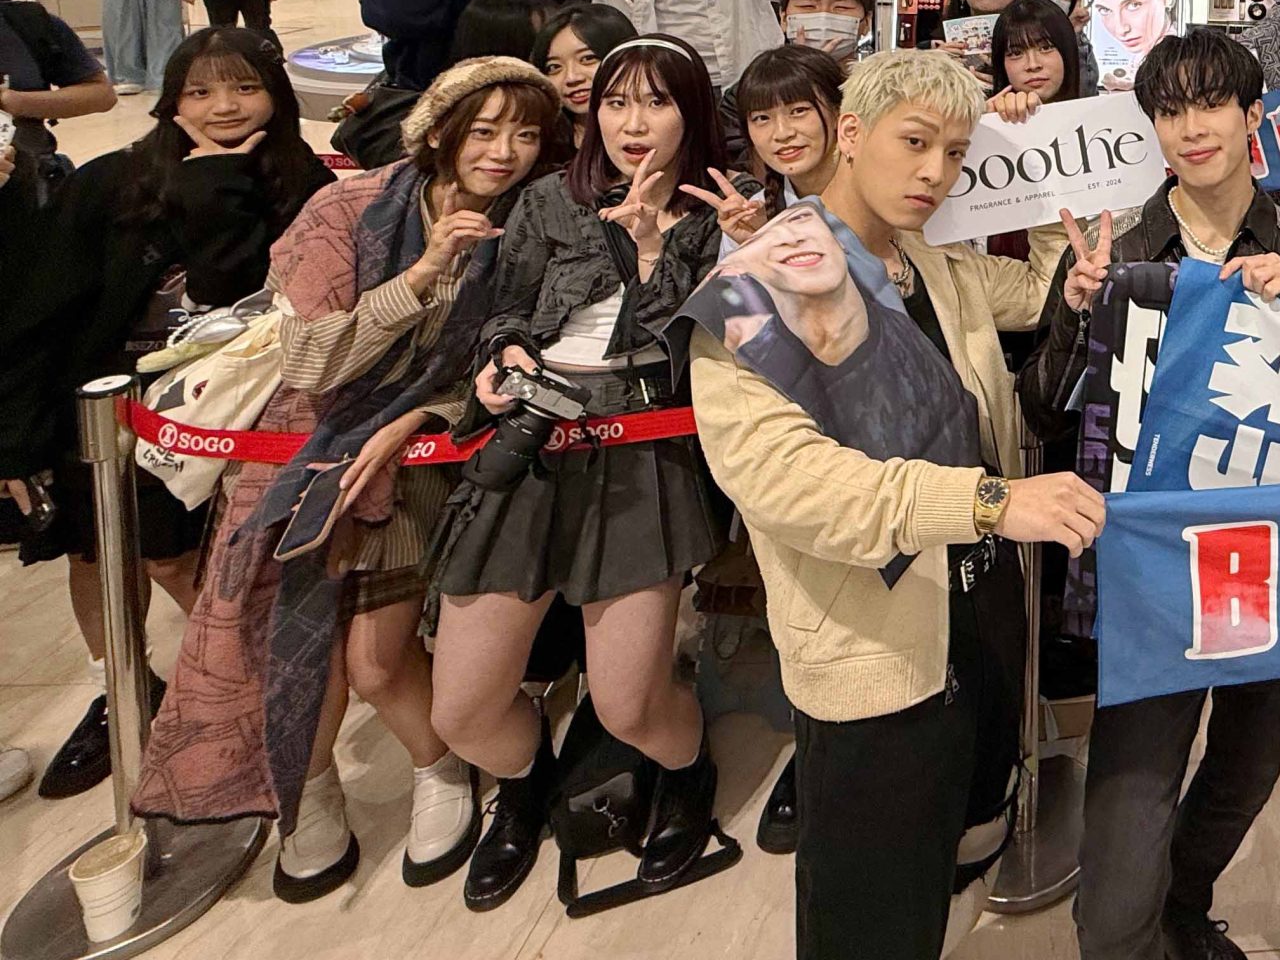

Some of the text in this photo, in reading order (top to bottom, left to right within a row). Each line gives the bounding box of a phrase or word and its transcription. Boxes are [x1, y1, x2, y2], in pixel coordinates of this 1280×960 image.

[336, 157, 356, 167] SO
[969, 198, 1012, 212] FRAGRANCE
[1024, 191, 1056, 202] APPAREL
[178, 432, 235, 453] SOGO
[404, 441, 436, 458] GO
[1183, 520, 1278, 661] B
